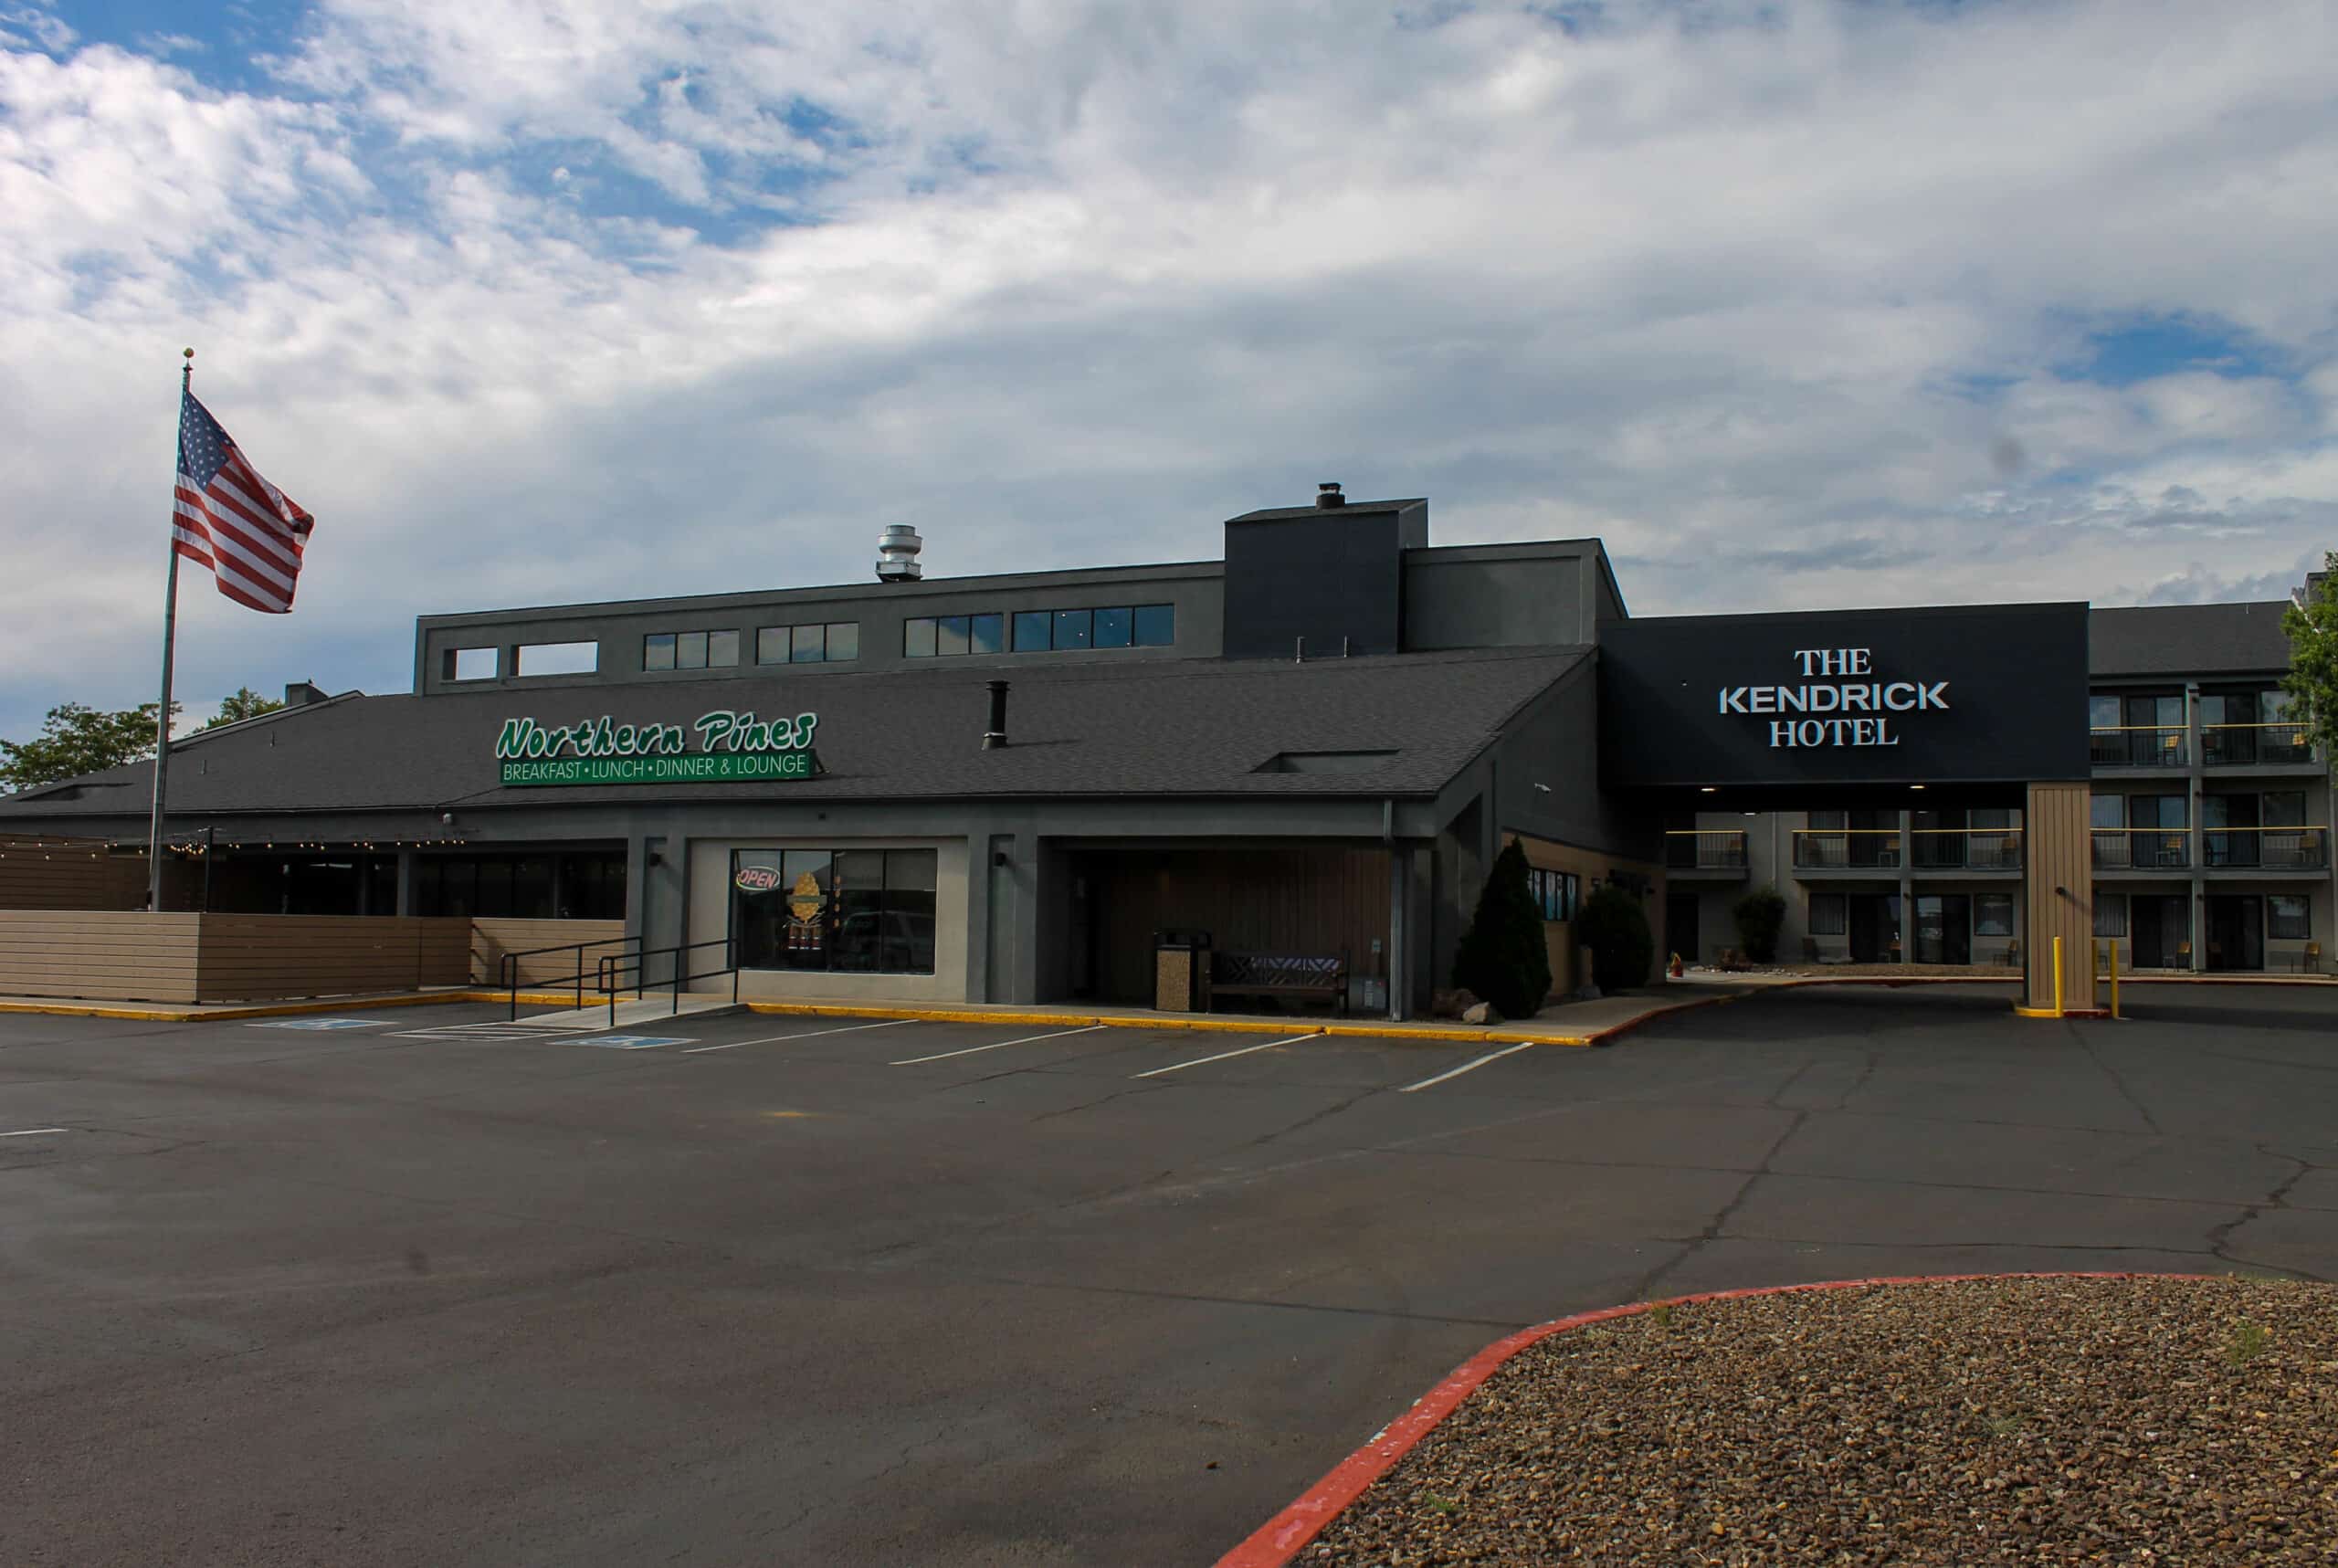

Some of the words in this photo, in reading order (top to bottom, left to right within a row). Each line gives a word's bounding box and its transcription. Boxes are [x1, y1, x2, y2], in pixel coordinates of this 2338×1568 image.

[1794, 647, 1872, 677] THE
[1719, 681, 1951, 714] KENDRICK
[495, 715, 686, 759] Northern
[694, 710, 817, 753] Pines
[1769, 718, 1900, 747] HOTEL
[503, 761, 581, 781] BREAKFAST
[592, 759, 644, 778] LUNCH
[656, 756, 714, 776] DINNER
[720, 757, 731, 774] &
[737, 753, 806, 774] LOUNGE
[739, 868, 777, 889] OPEN
